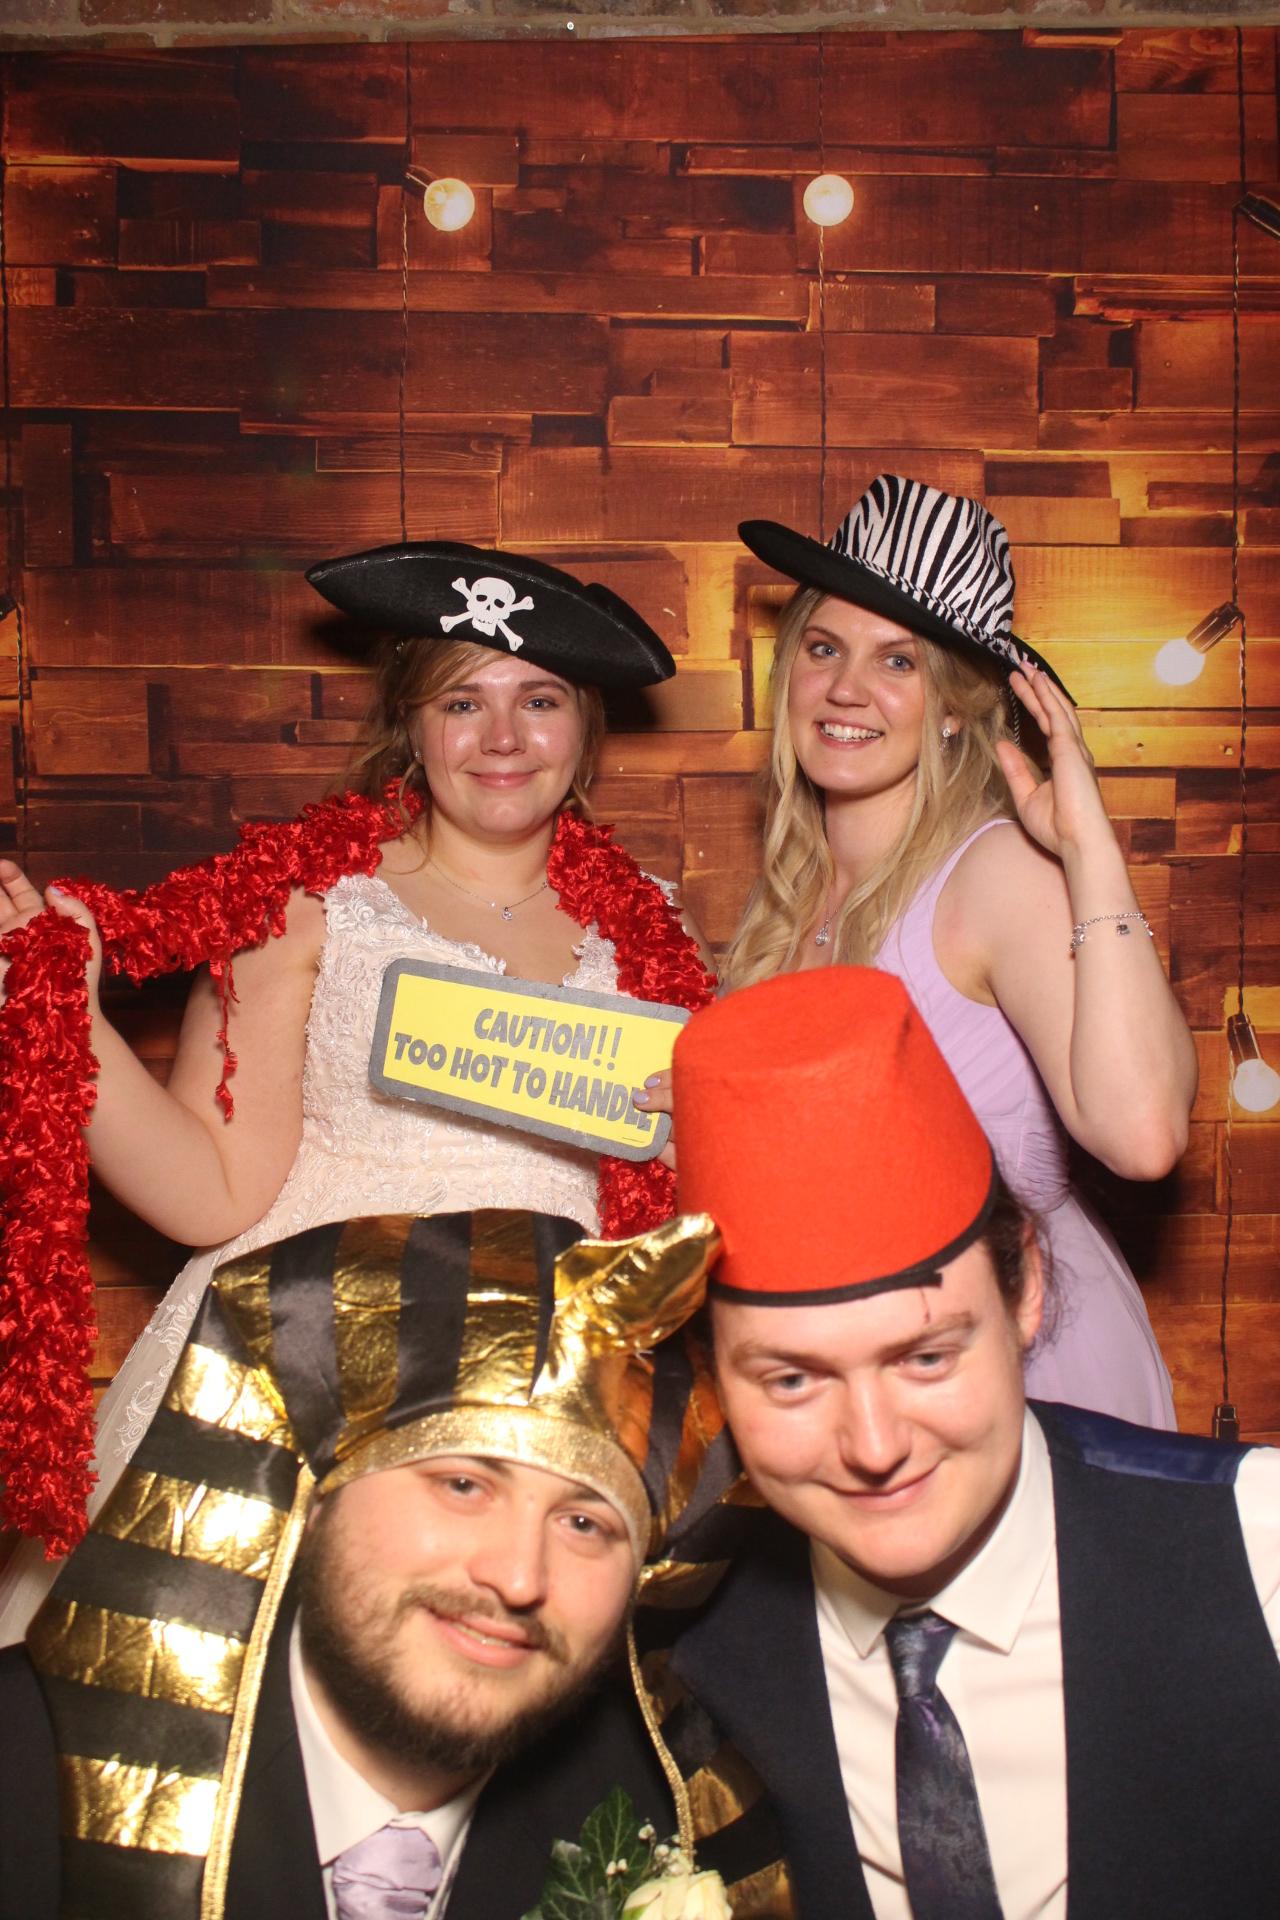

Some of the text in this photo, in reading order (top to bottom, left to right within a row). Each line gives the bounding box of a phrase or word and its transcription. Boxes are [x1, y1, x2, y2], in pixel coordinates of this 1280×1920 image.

[394, 1032, 447, 1070] TOO
[449, 1046, 508, 1088] HOT
[512, 1060, 547, 1099] TO
[474, 1008, 623, 1071] CAUTION!!
